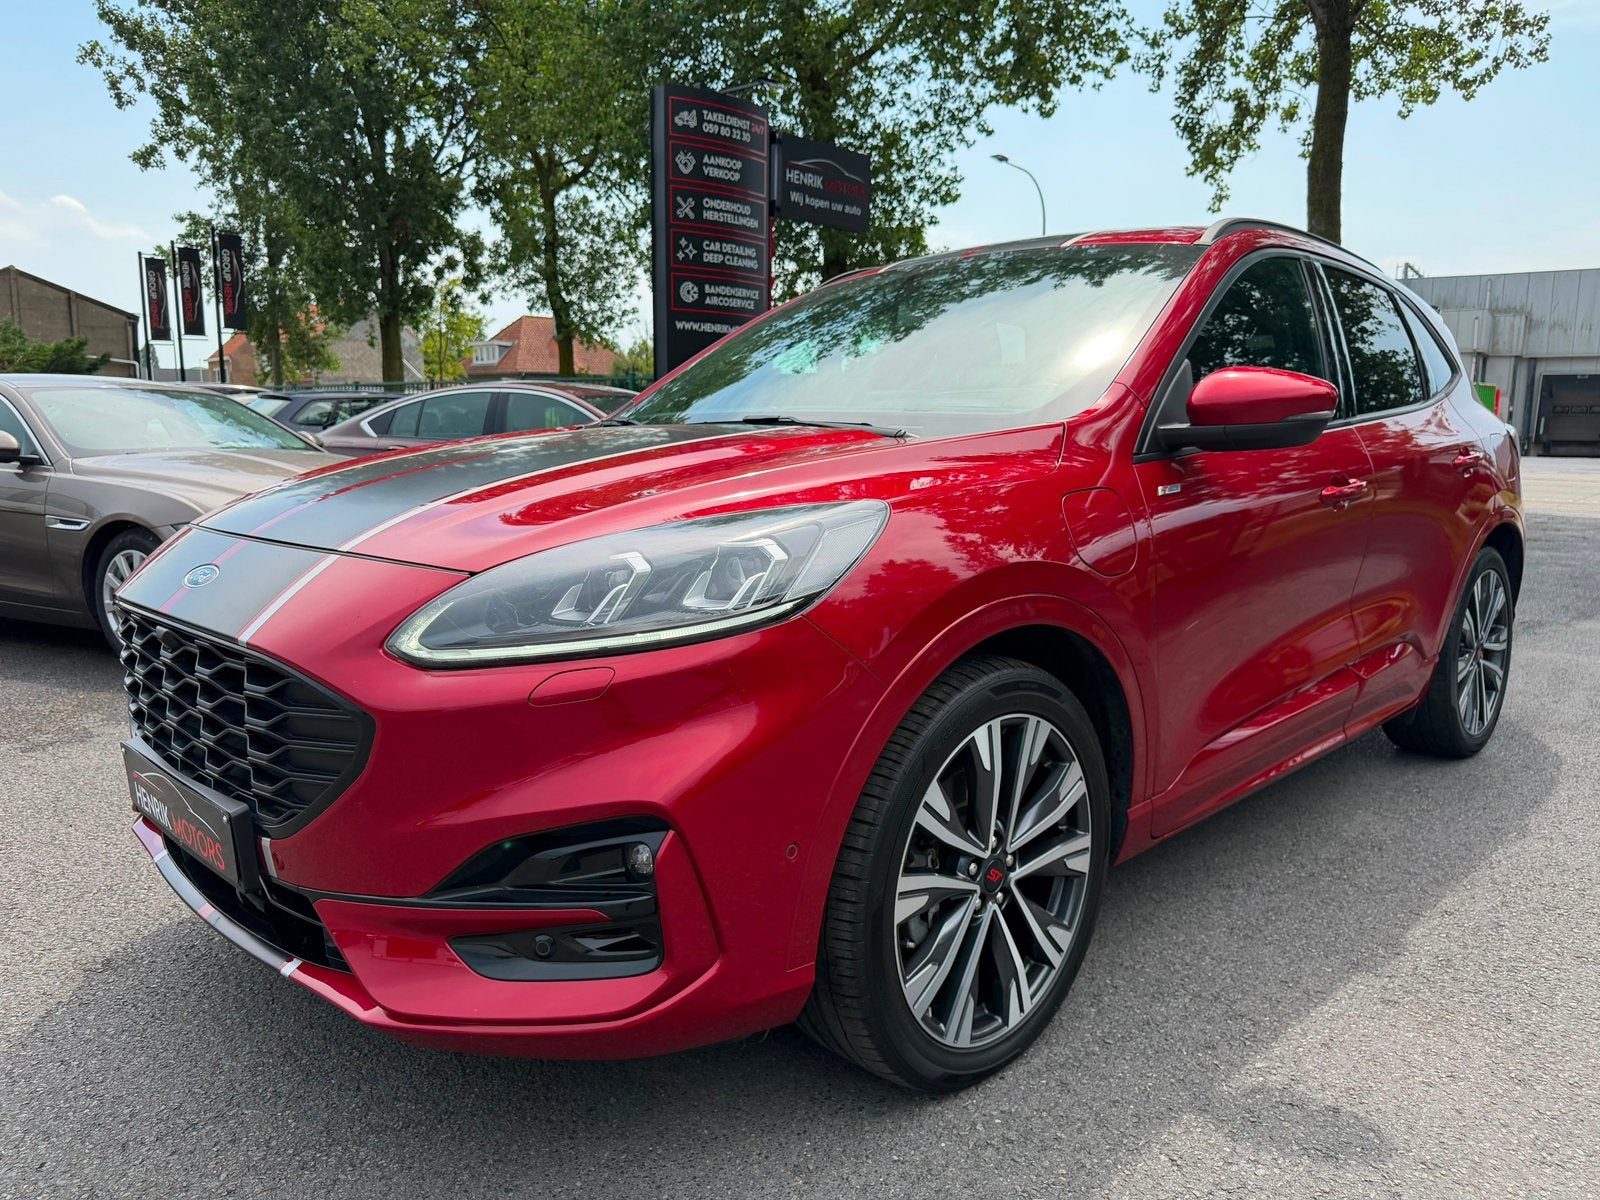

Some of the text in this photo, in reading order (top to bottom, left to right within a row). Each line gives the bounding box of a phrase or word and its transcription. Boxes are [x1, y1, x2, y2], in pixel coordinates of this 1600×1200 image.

[702, 110, 750, 130] TAKELDIENST
[702, 122, 751, 143] 059 80 32 30
[703, 154, 742, 170] AANKOOP
[702, 165, 741, 181] VERKOOP
[785, 168, 823, 189] HENRIK
[703, 197, 751, 215] ONDERHOUD
[789, 190, 862, 216] Wij kopen uw auto
[703, 209, 759, 228] HERSTELLINGEN
[703, 240, 757, 258] CAR DETAILING
[220, 248, 231, 282] GROUP
[703, 252, 759, 270] DEEP CLEANING
[148, 270, 157, 299] GROUP
[704, 284, 760, 300] BANDENSERVICE
[704, 296, 755, 310] AIRCOSERVICE
[134, 781, 225, 871] HENRIK MOTORS
